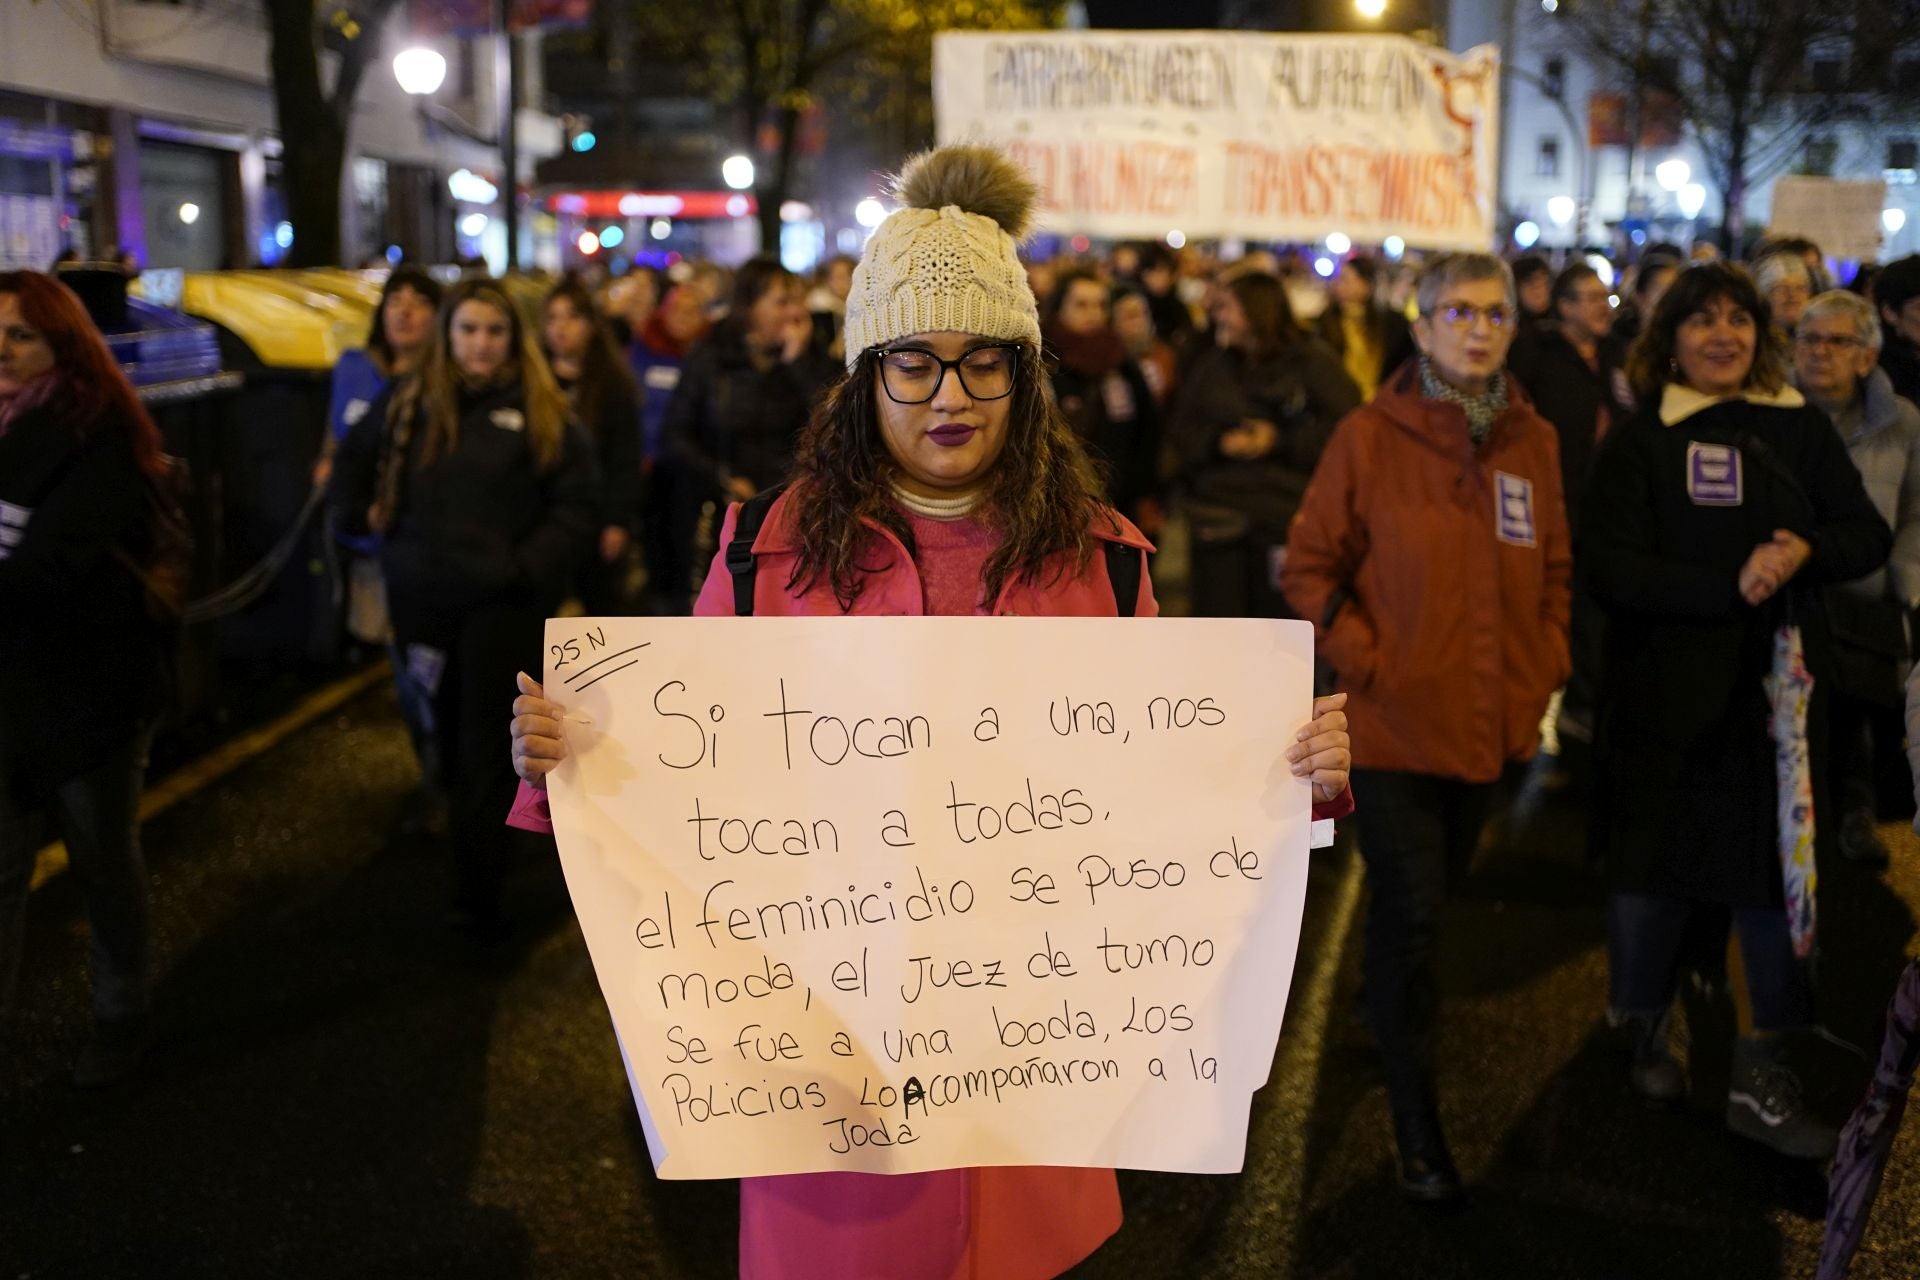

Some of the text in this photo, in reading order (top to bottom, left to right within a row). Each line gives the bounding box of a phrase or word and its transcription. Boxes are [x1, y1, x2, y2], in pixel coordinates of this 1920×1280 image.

[653, 679, 726, 770] Si
[762, 677, 931, 771] tocan
[973, 706, 1000, 743] a
[1147, 696, 1227, 732] nos
[686, 797, 840, 861] tocan
[881, 809, 917, 848] a
[635, 890, 677, 950] el
[695, 864, 976, 950] feminicidio
[1208, 835, 1264, 882] de
[657, 954, 812, 1013] moda,
[830, 946, 869, 999] el
[1026, 930, 1079, 980] de
[732, 1024, 805, 1063] fue
[829, 1031, 856, 1058] a
[991, 998, 1111, 1049] boda,
[1147, 1056, 1169, 1083] a
[1188, 1046, 1219, 1085] la
